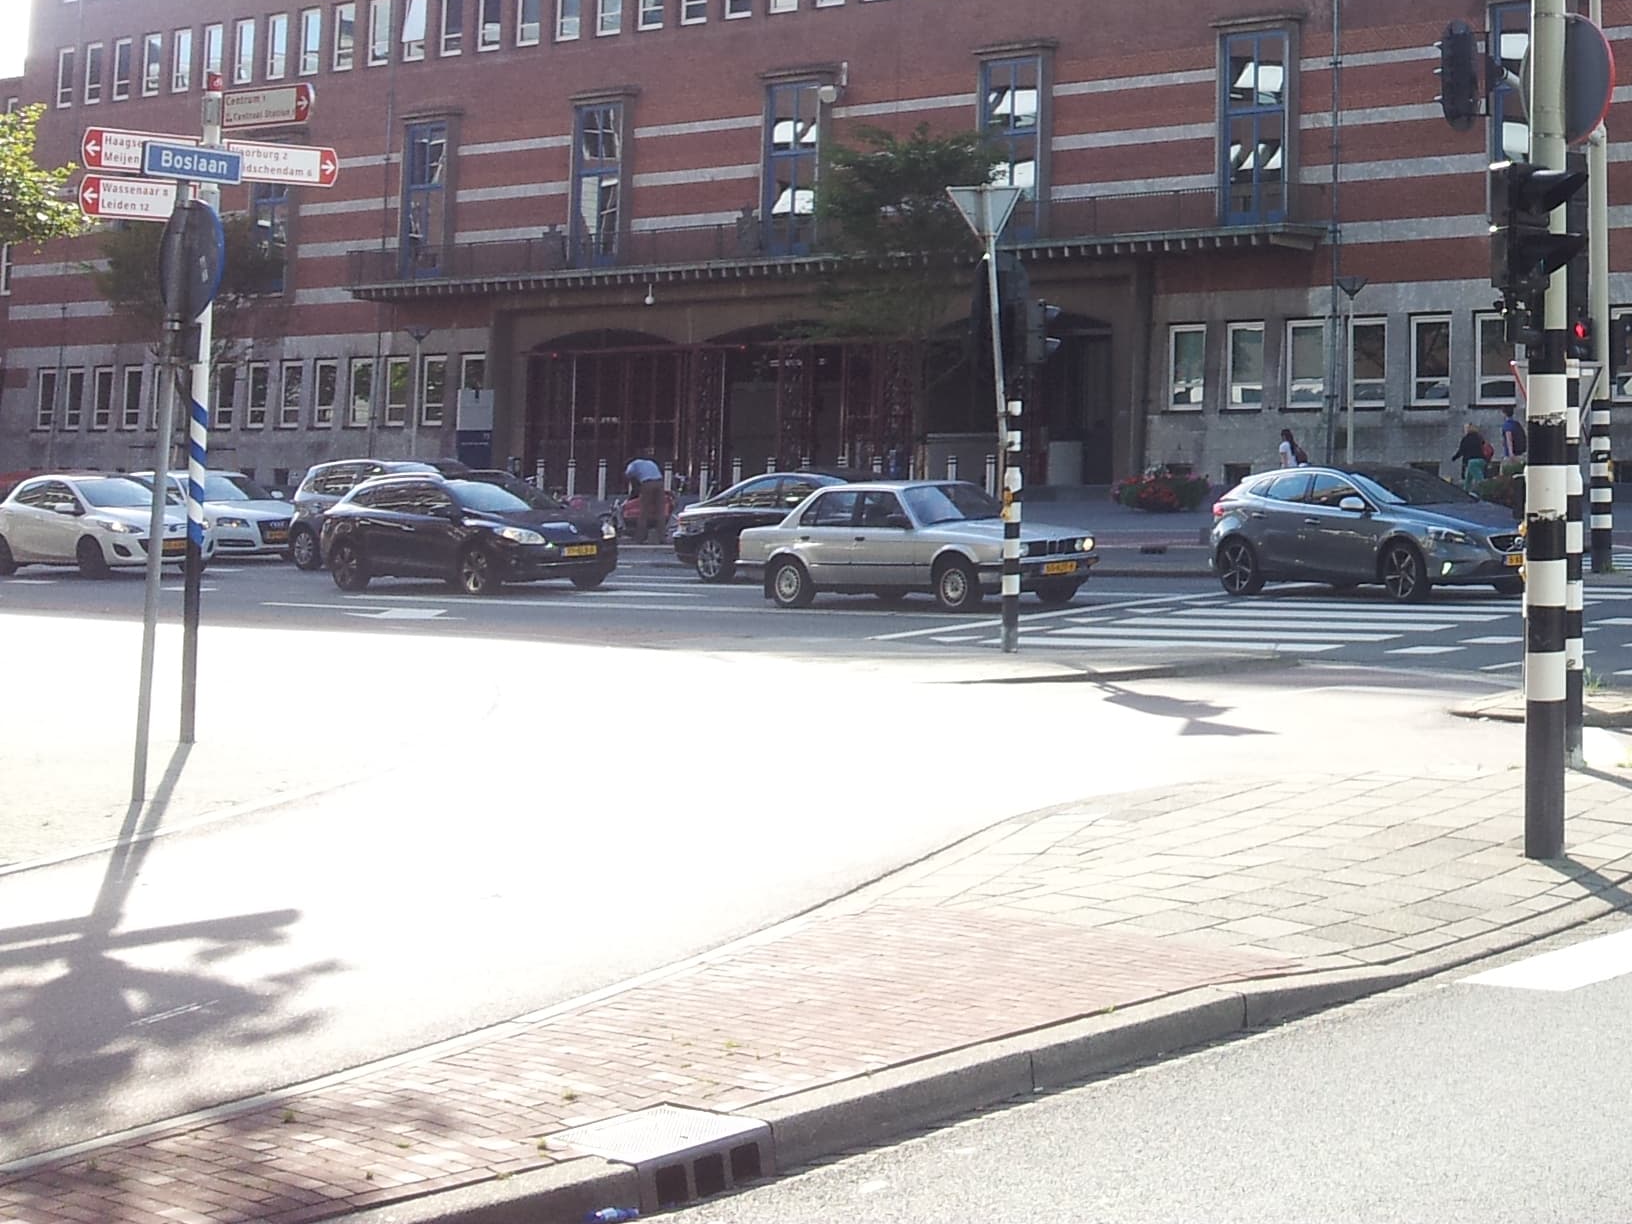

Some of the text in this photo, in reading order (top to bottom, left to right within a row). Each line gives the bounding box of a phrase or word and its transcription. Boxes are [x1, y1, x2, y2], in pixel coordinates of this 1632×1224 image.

[226, 95, 260, 106] Centrum
[161, 150, 228, 175] Boslaan
[243, 162, 304, 176] dschendam
[102, 182, 159, 196] Wassenaar
[101, 198, 150, 211] Leiden 12
